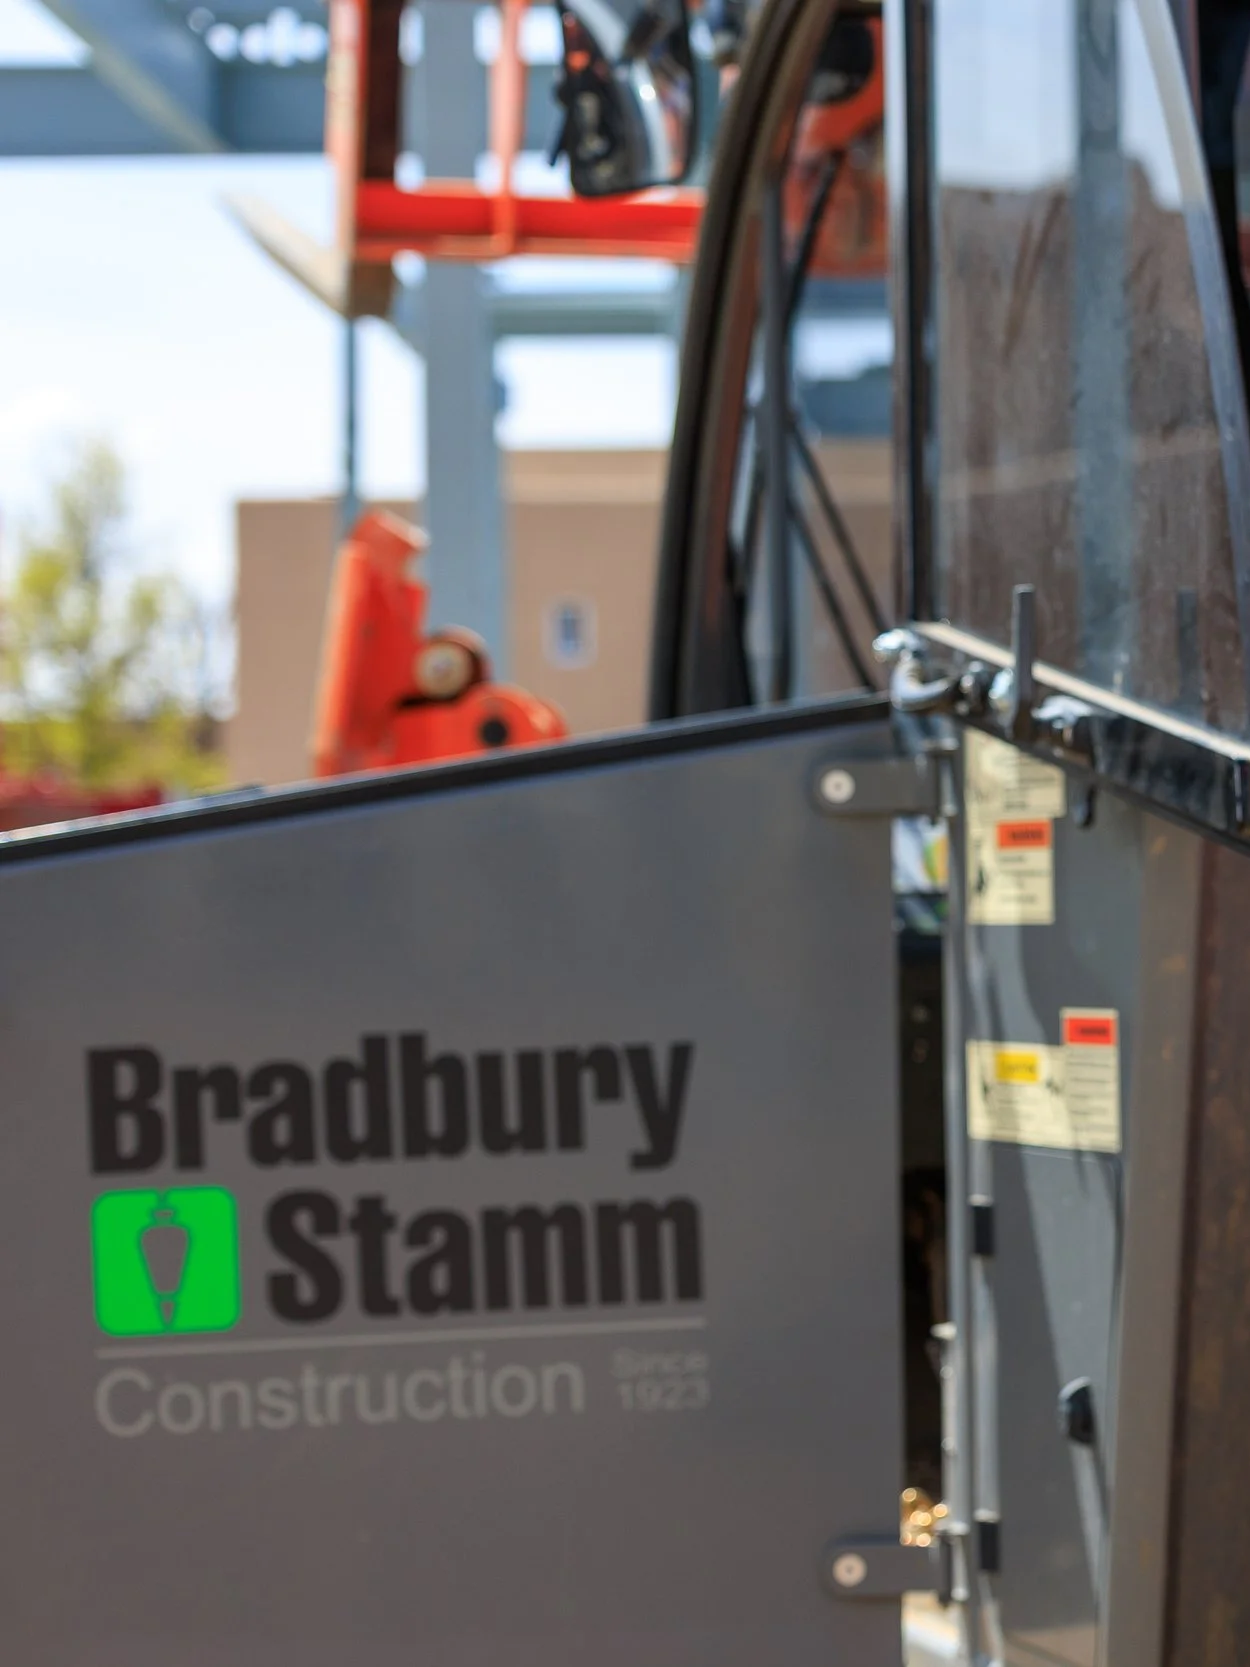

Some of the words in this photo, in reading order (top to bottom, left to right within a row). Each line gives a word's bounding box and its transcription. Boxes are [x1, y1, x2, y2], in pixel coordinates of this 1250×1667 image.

[86, 1031, 694, 1177] Bradbury
[264, 1188, 703, 1326] Stamm
[95, 1351, 585, 1437] Construction
